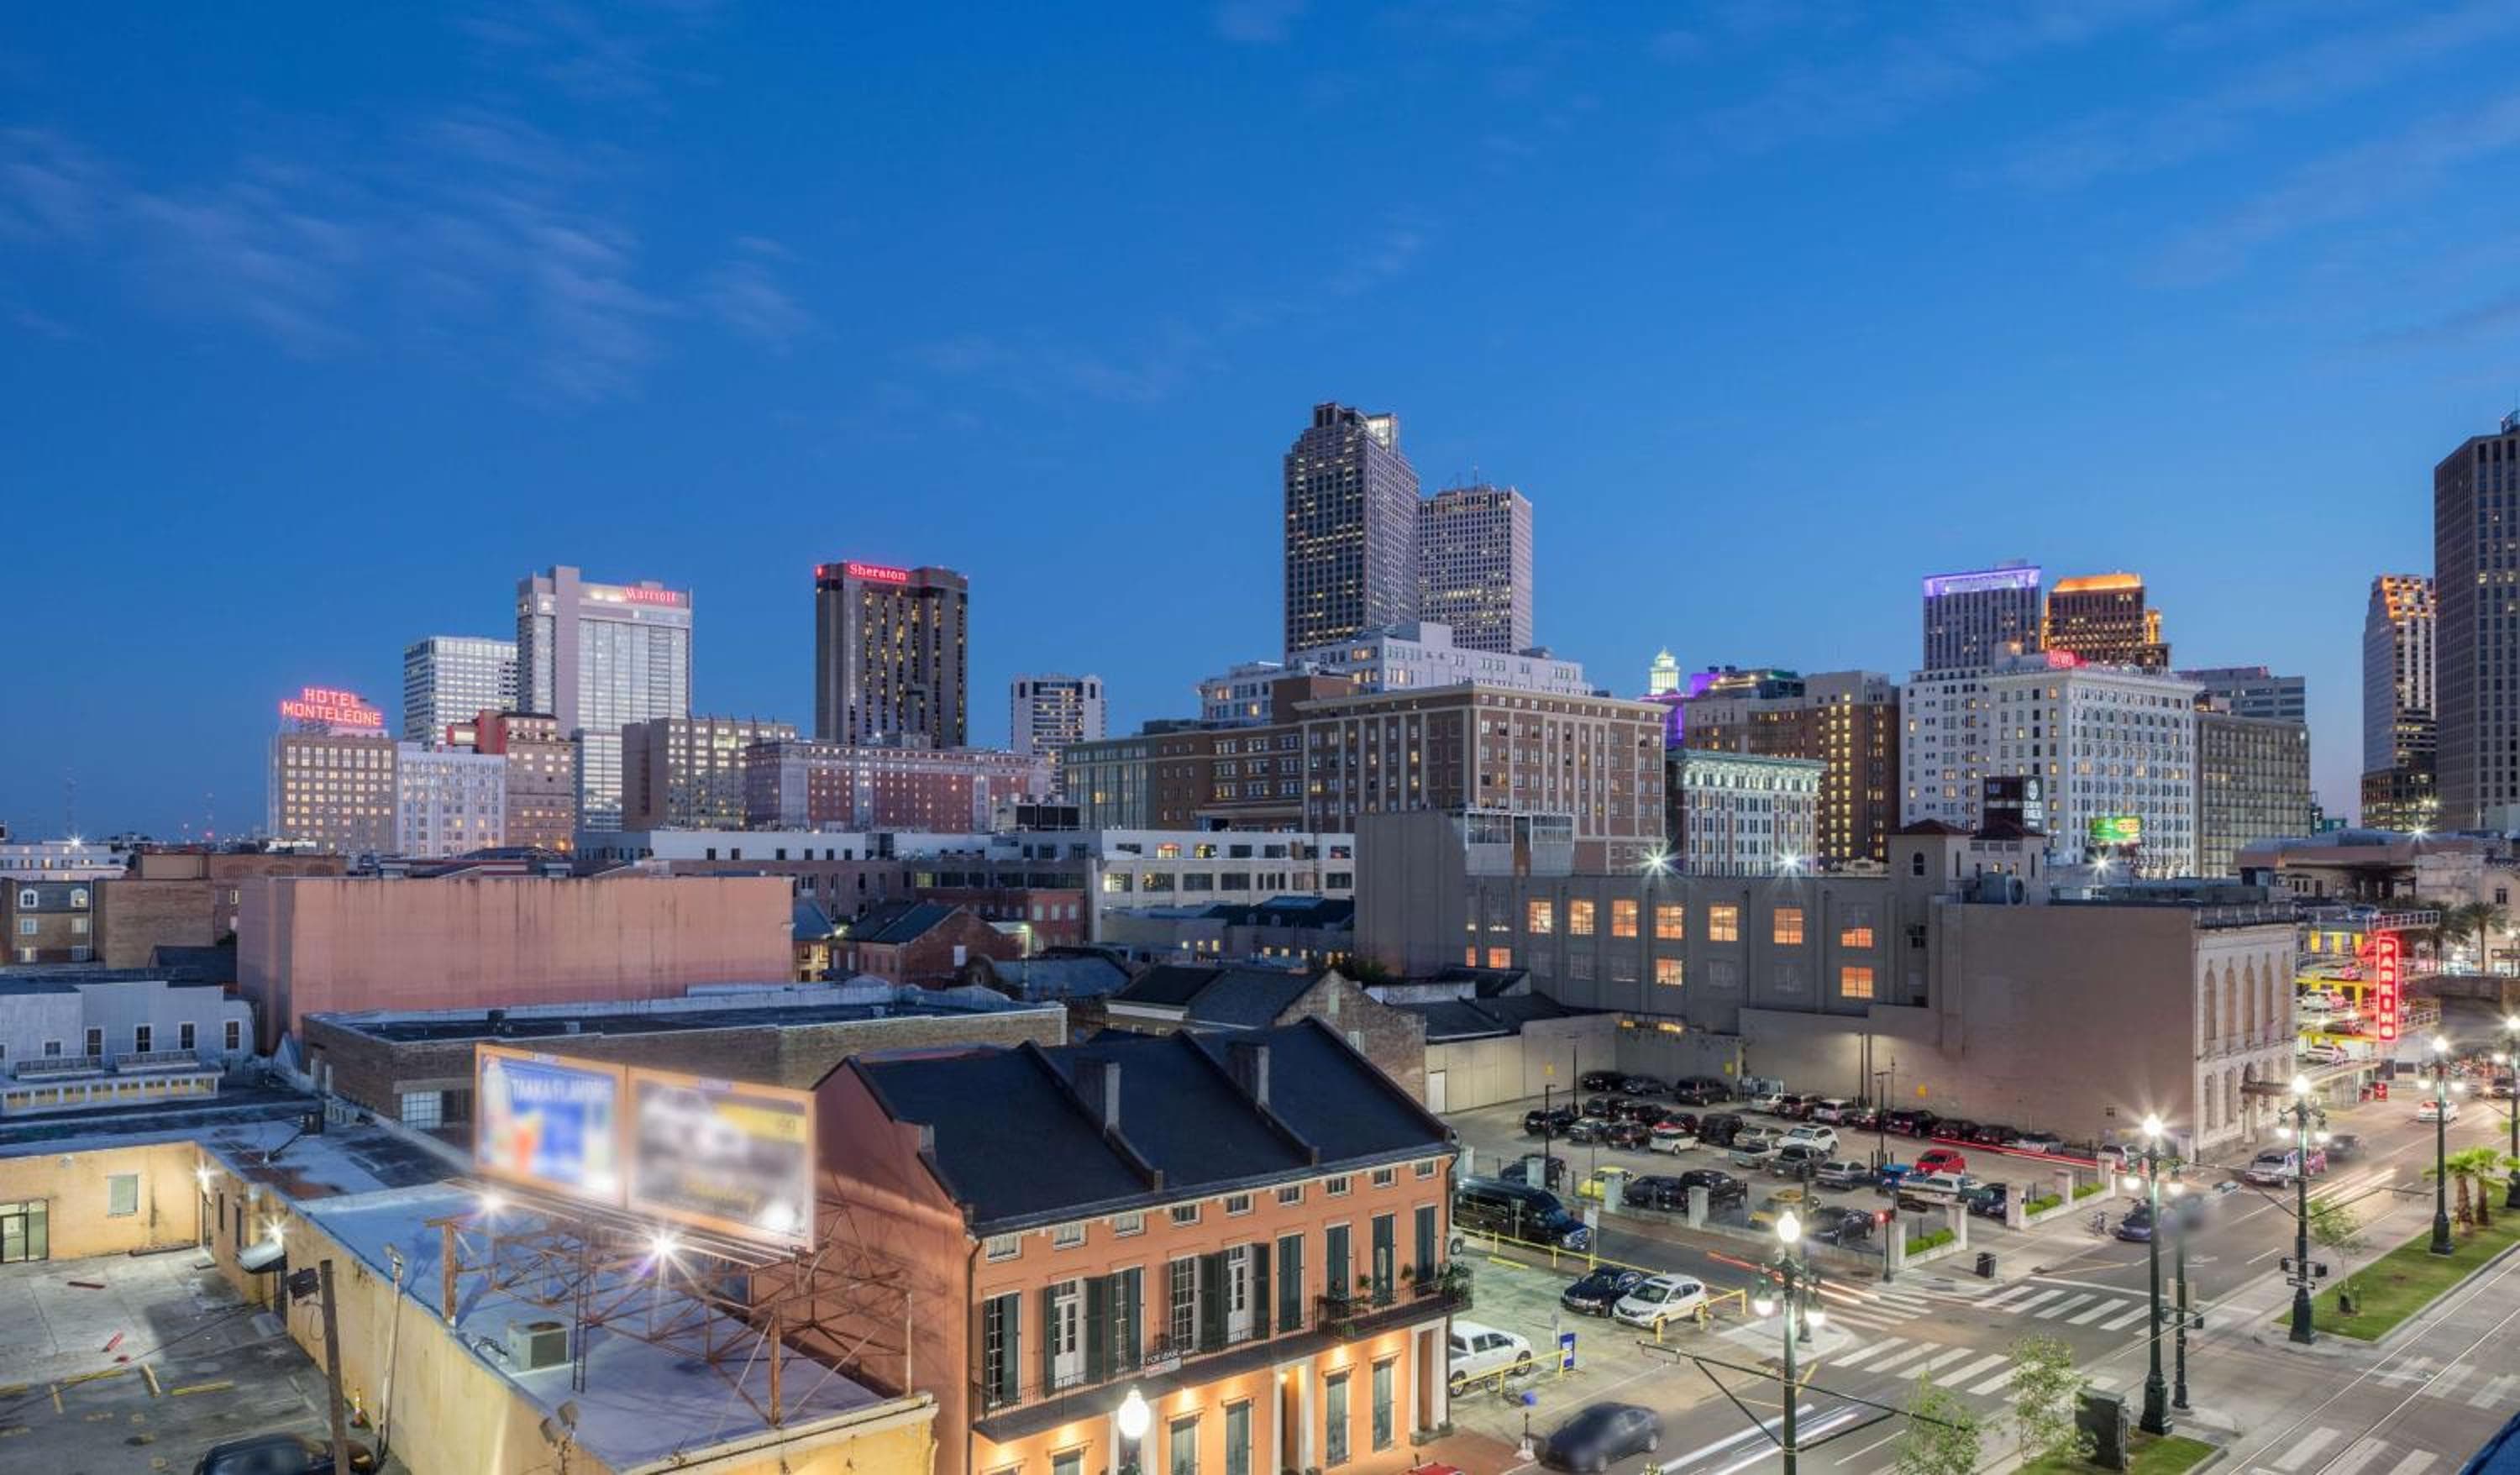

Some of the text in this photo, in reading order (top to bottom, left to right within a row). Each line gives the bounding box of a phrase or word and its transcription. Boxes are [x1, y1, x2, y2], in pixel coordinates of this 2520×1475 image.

[849, 564, 906, 581] Sheraton
[303, 688, 360, 708] HOTEL
[282, 701, 382, 726] MONTELEONE
[2380, 942, 2395, 1038] PARKING
